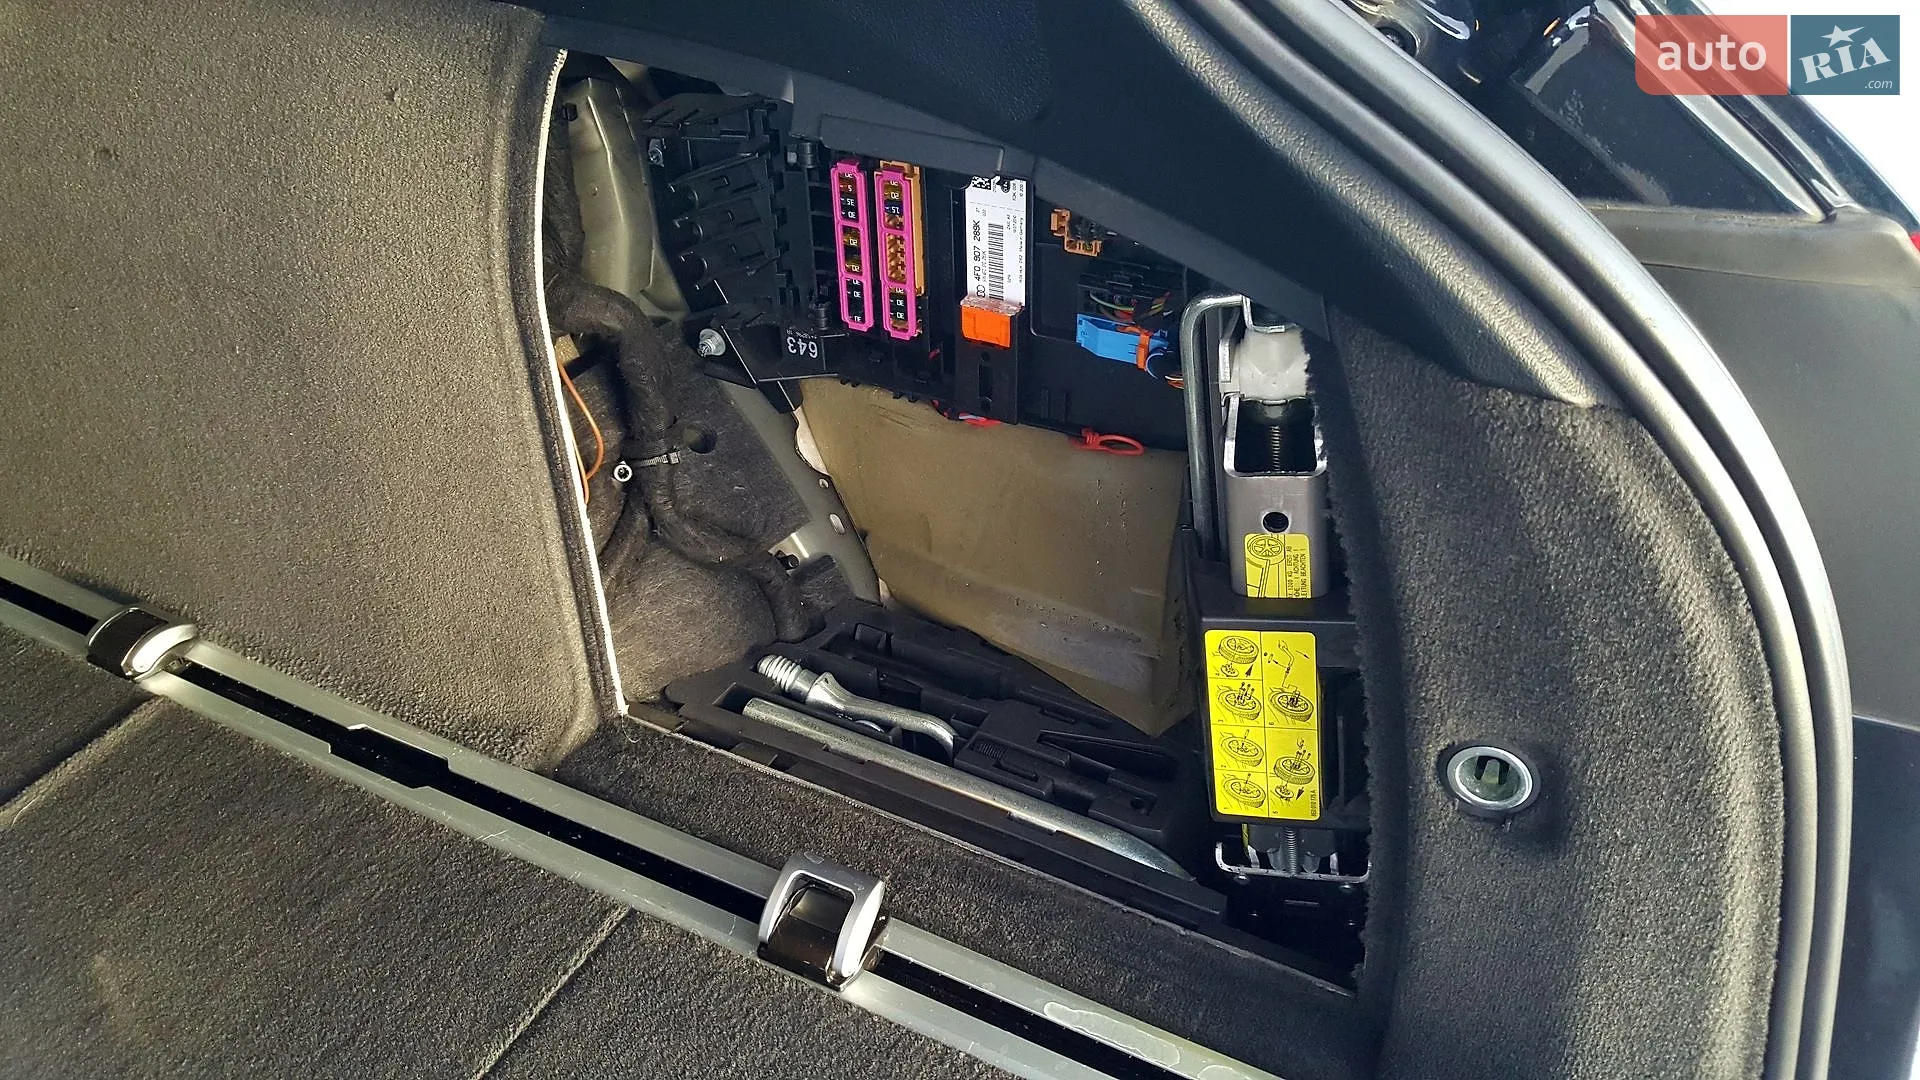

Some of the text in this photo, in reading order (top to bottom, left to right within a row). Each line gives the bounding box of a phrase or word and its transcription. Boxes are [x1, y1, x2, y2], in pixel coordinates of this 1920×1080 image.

[890, 191, 900, 200] 20
[848, 210, 856, 218] 30
[891, 206, 900, 215] 15
[972, 219, 981, 242] 289K
[973, 245, 981, 262] 907
[973, 266, 981, 282] 4F0
[853, 291, 862, 299] 30
[896, 299, 905, 307] 30
[896, 311, 905, 320] 30
[786, 336, 818, 359] 643
